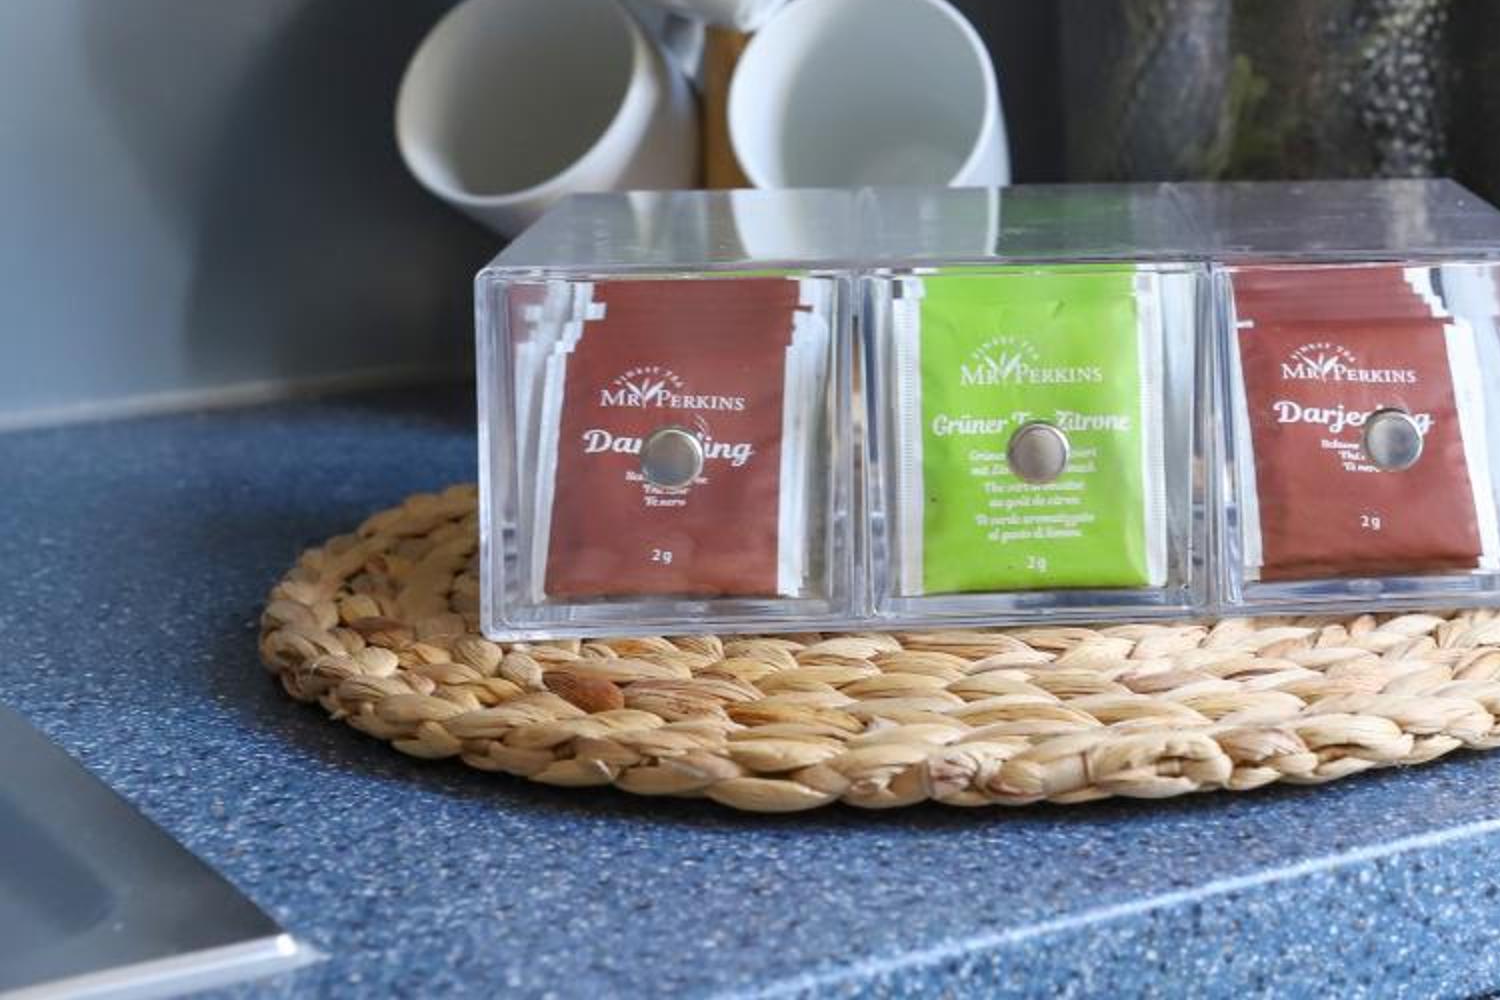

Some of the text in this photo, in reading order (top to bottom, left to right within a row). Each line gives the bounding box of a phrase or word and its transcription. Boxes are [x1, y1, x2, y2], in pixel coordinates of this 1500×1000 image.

[1016, 363, 1102, 384] PERKINS
[1334, 363, 1417, 383] PERKINS
[656, 389, 745, 410] PERKINS
